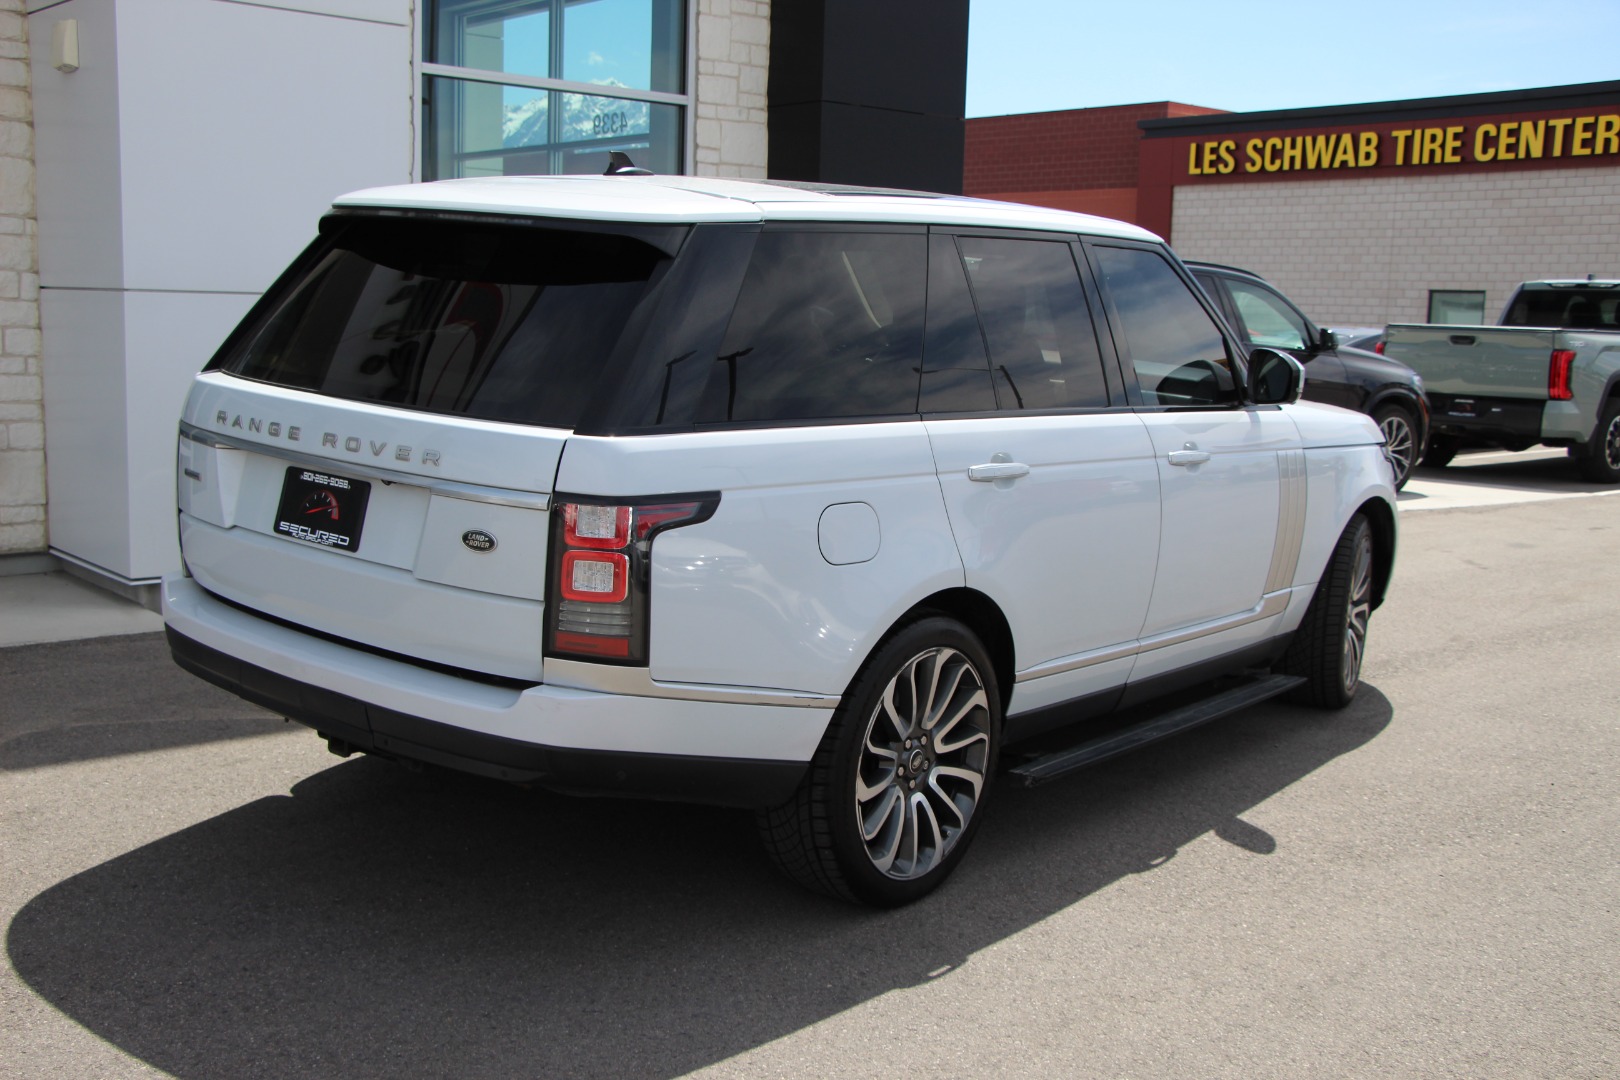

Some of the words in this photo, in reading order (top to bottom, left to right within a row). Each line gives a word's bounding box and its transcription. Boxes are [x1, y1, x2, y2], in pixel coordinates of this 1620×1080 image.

[1188, 140, 1236, 175] LES
[1245, 132, 1378, 173] SCHWAB
[1392, 126, 1464, 166] TIRE
[1474, 115, 1620, 162] CENTER
[216, 410, 301, 441] RANGE
[322, 432, 441, 466] ROVER
[279, 521, 350, 546] SECURED
